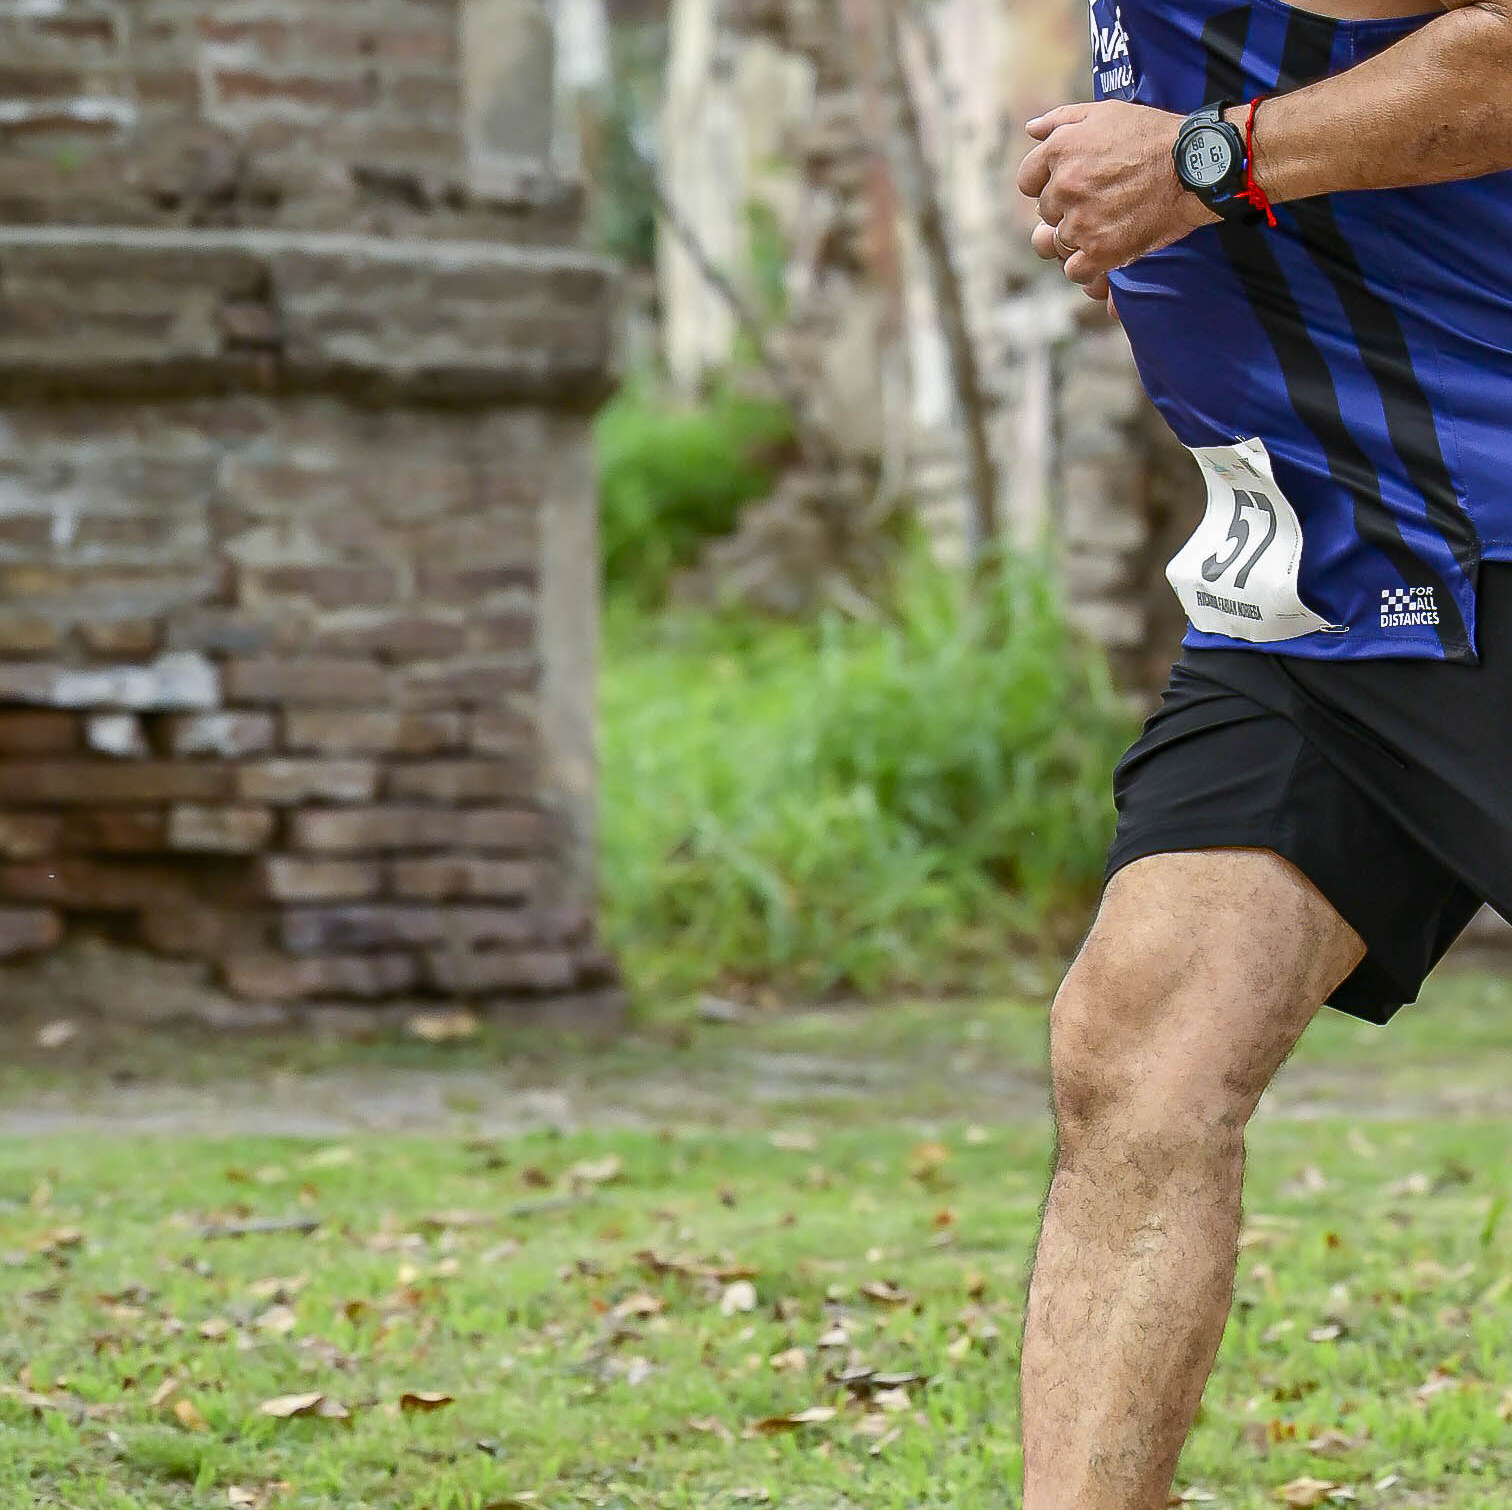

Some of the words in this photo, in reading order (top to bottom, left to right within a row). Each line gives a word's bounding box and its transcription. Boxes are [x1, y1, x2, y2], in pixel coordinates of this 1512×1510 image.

[1201, 487, 1277, 589] 57
[1409, 586, 1434, 596] FOR
[1416, 596, 1438, 610] ALL
[1380, 611, 1440, 628] DISTANCES
